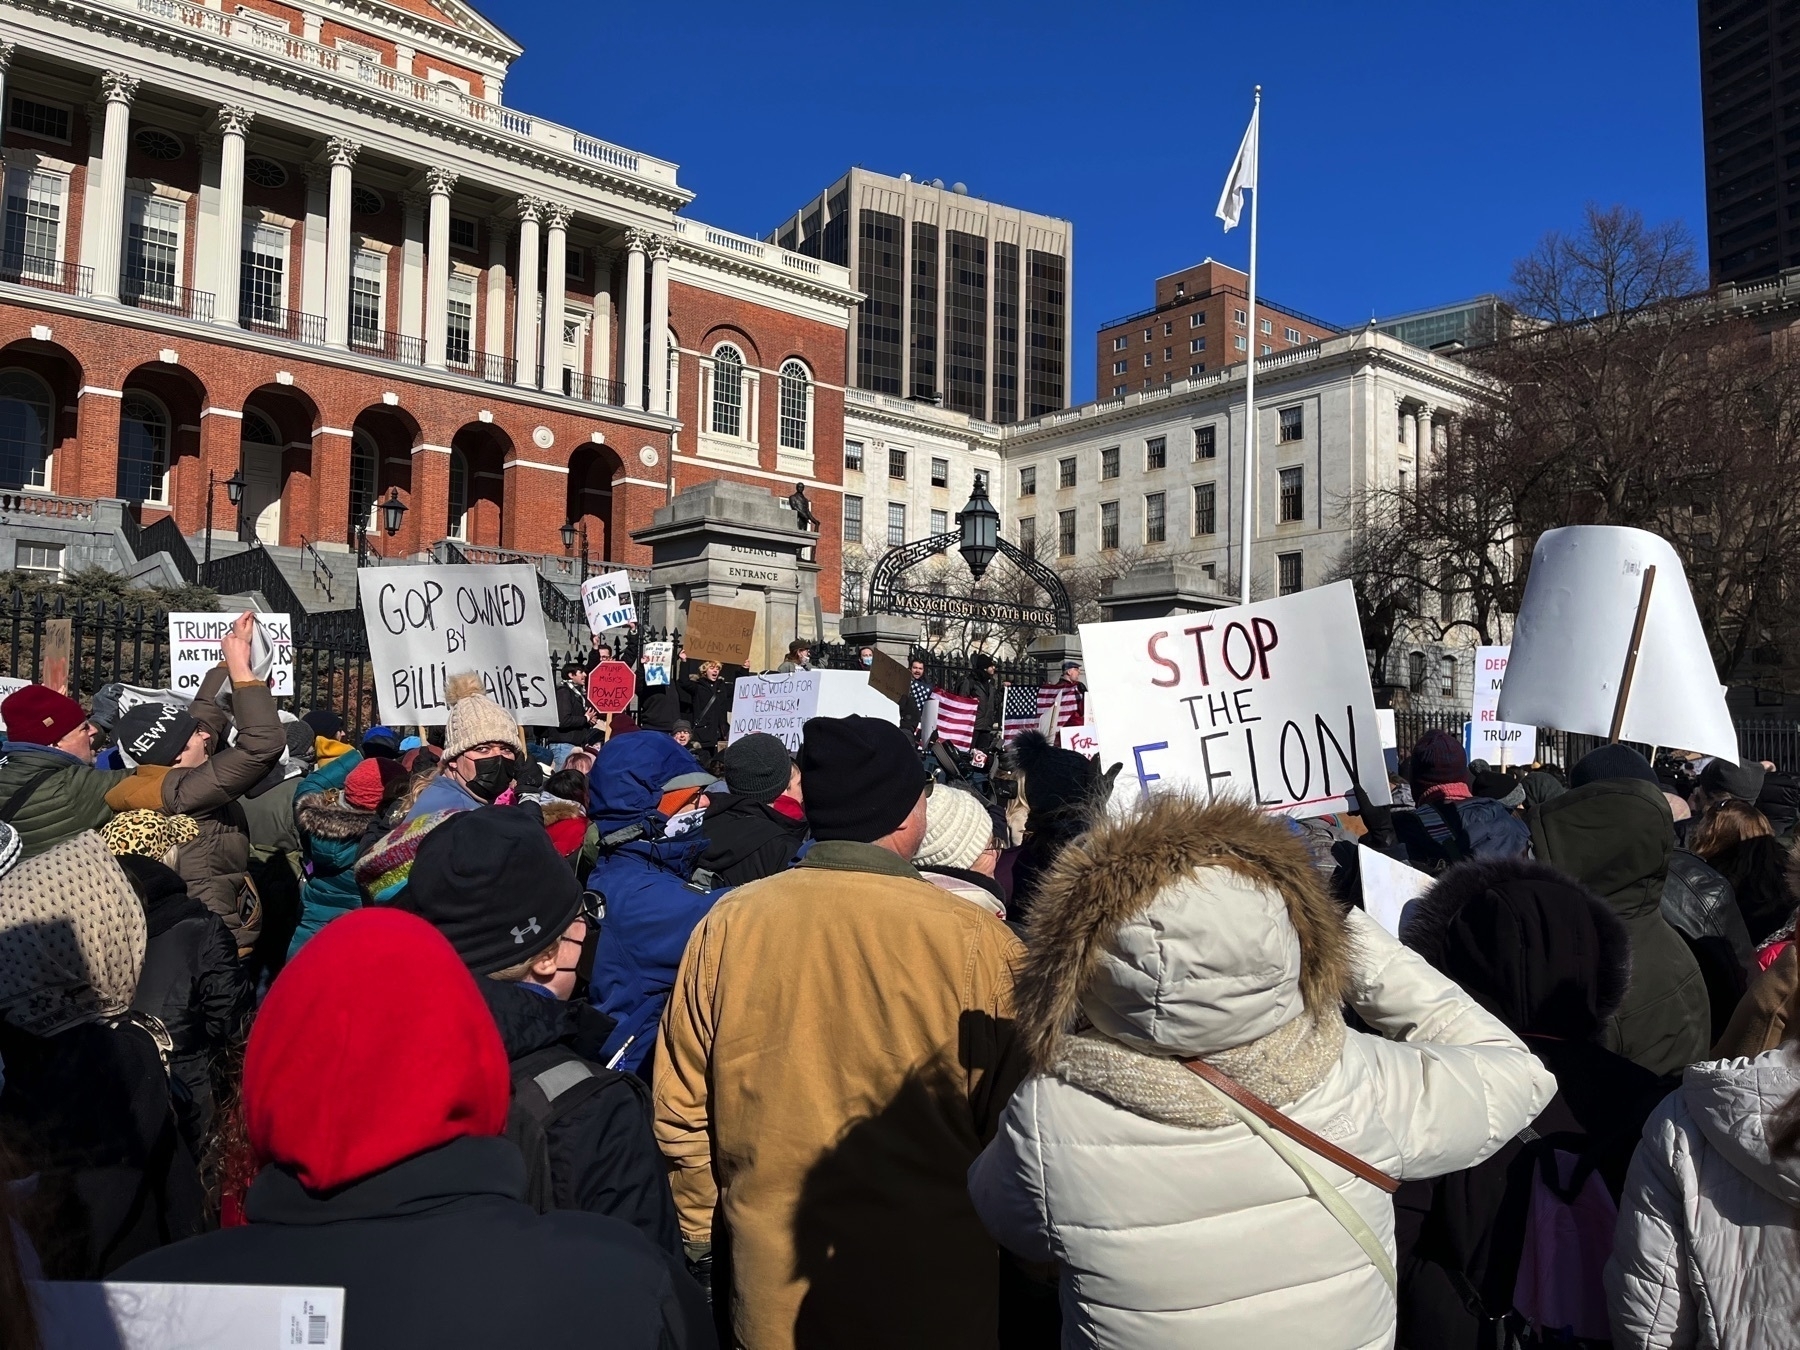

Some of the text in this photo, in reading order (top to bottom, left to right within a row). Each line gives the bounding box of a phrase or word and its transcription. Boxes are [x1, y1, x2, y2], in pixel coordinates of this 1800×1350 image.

[730, 545, 777, 558] BULFINCH
[729, 567, 779, 581] ENTRANCE
[586, 584, 617, 607] ELON
[456, 583, 526, 627] OWNED
[895, 595, 1056, 624] MASSACHUSETTS STATE HOUSE
[602, 608, 633, 627] YOU
[446, 624, 467, 653] BY
[689, 637, 707, 652] YOU
[706, 640, 725, 654] AND
[178, 649, 200, 661] ARE
[1147, 617, 1279, 688] STOP
[178, 674, 200, 688] OR
[739, 680, 812, 698] NO ONE VOTED FOR
[592, 686, 628, 699] POWER
[596, 698, 621, 708] GRAB
[1180, 688, 1262, 730] THE
[734, 719, 746, 733] NO
[748, 717, 763, 732] ONE
[765, 717, 772, 729] IS
[773, 716, 795, 729] ABOVE
[128, 721, 167, 757] NEW
[1070, 732, 1099, 751] FOR
